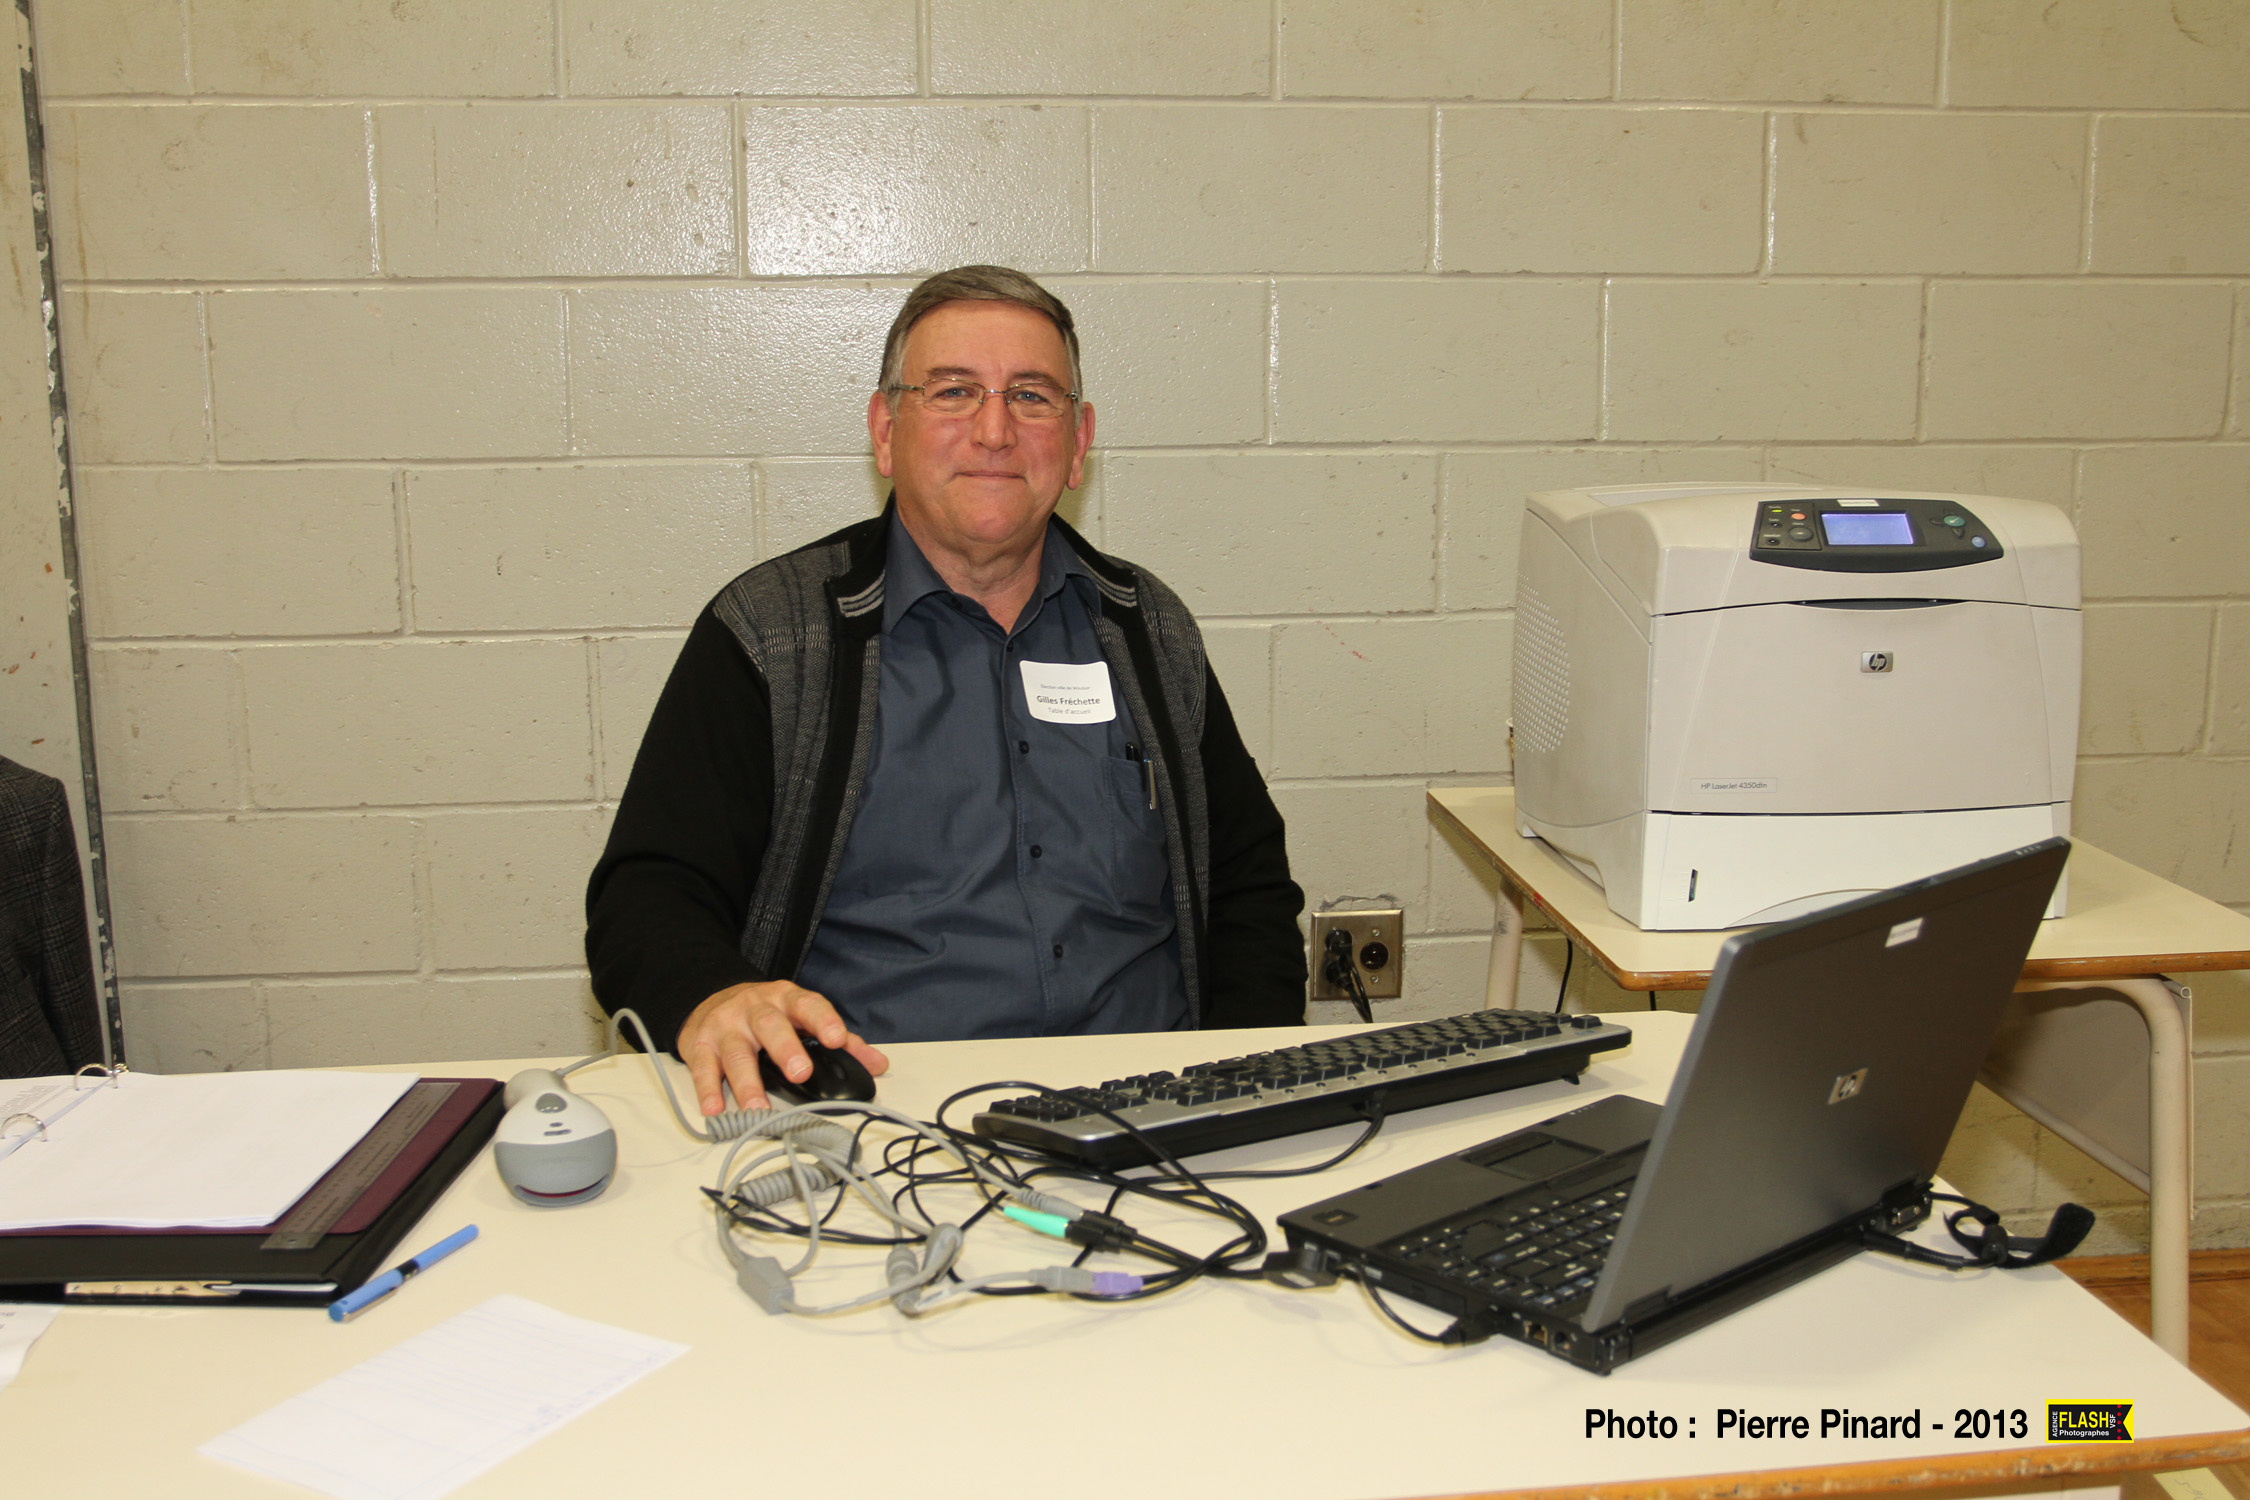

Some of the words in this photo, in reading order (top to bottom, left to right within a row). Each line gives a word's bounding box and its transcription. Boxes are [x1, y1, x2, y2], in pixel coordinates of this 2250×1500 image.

[1869, 653, 1887, 671] hp
[1036, 695, 1058, 704] Gilles
[1060, 697, 1101, 705] Fréchette
